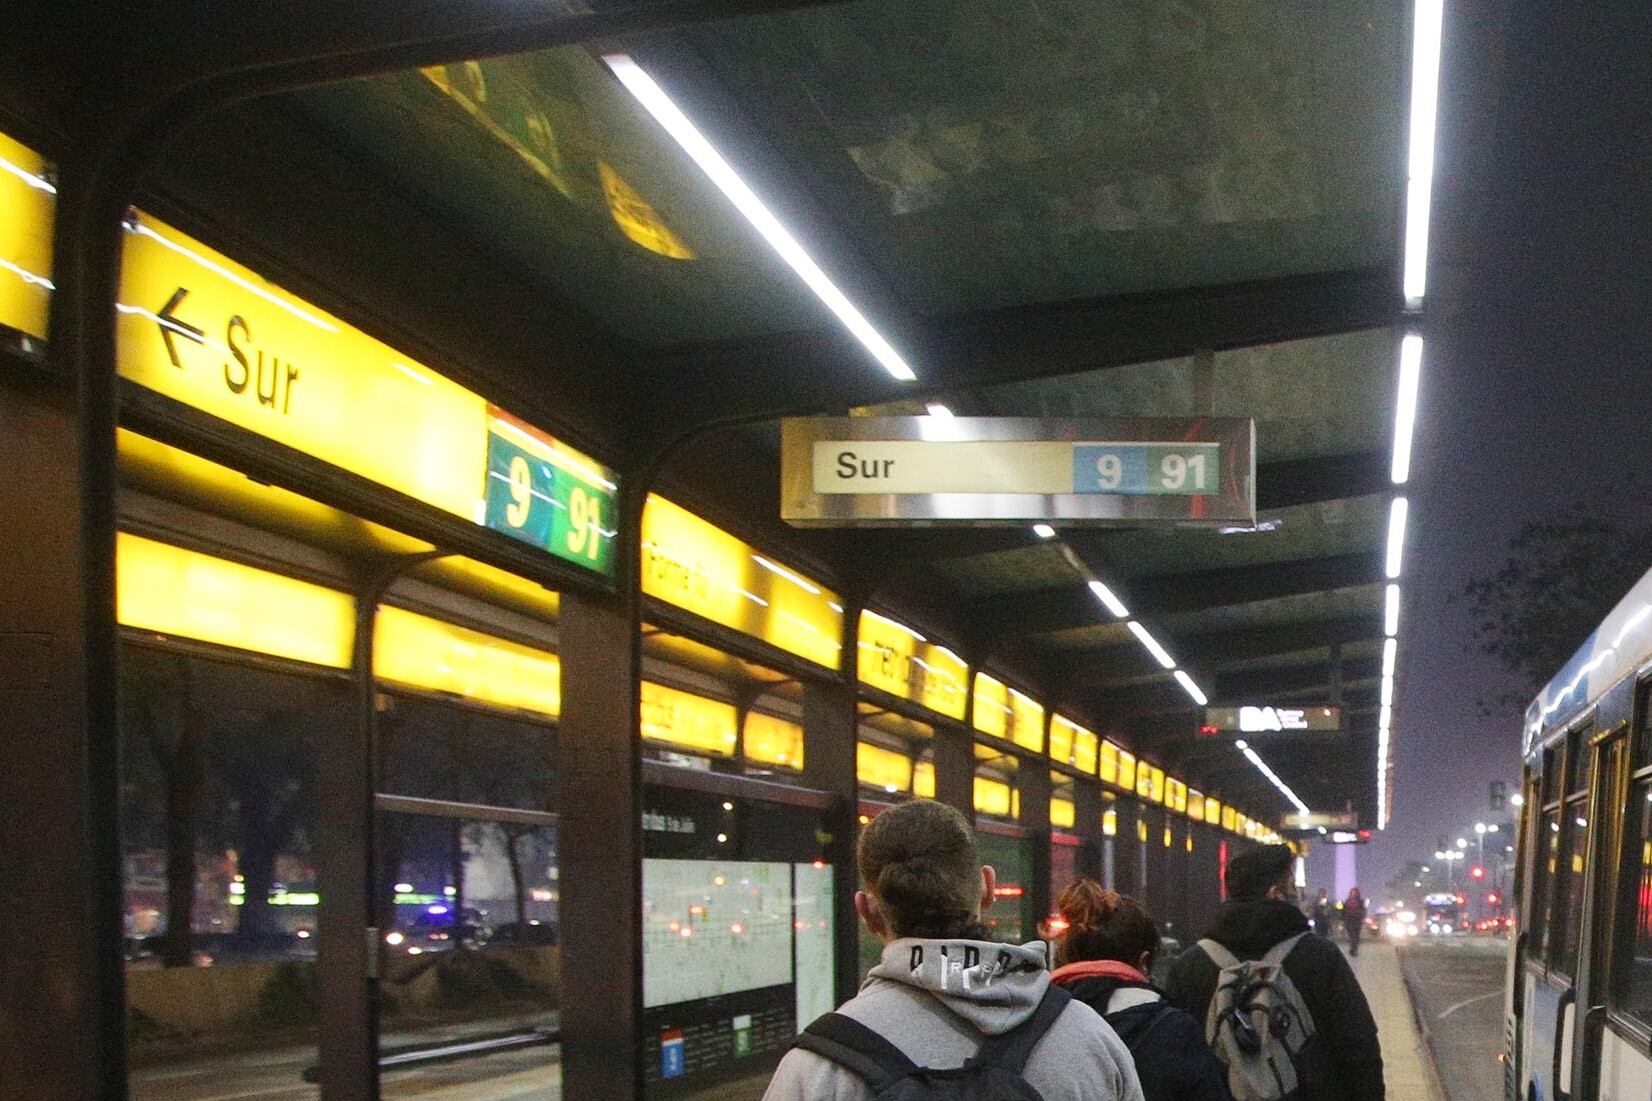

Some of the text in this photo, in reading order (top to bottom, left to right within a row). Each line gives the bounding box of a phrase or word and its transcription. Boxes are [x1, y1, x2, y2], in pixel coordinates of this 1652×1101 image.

[224, 314, 600, 561] Sur 9 91
[836, 451, 1206, 489] Sur 9 91
